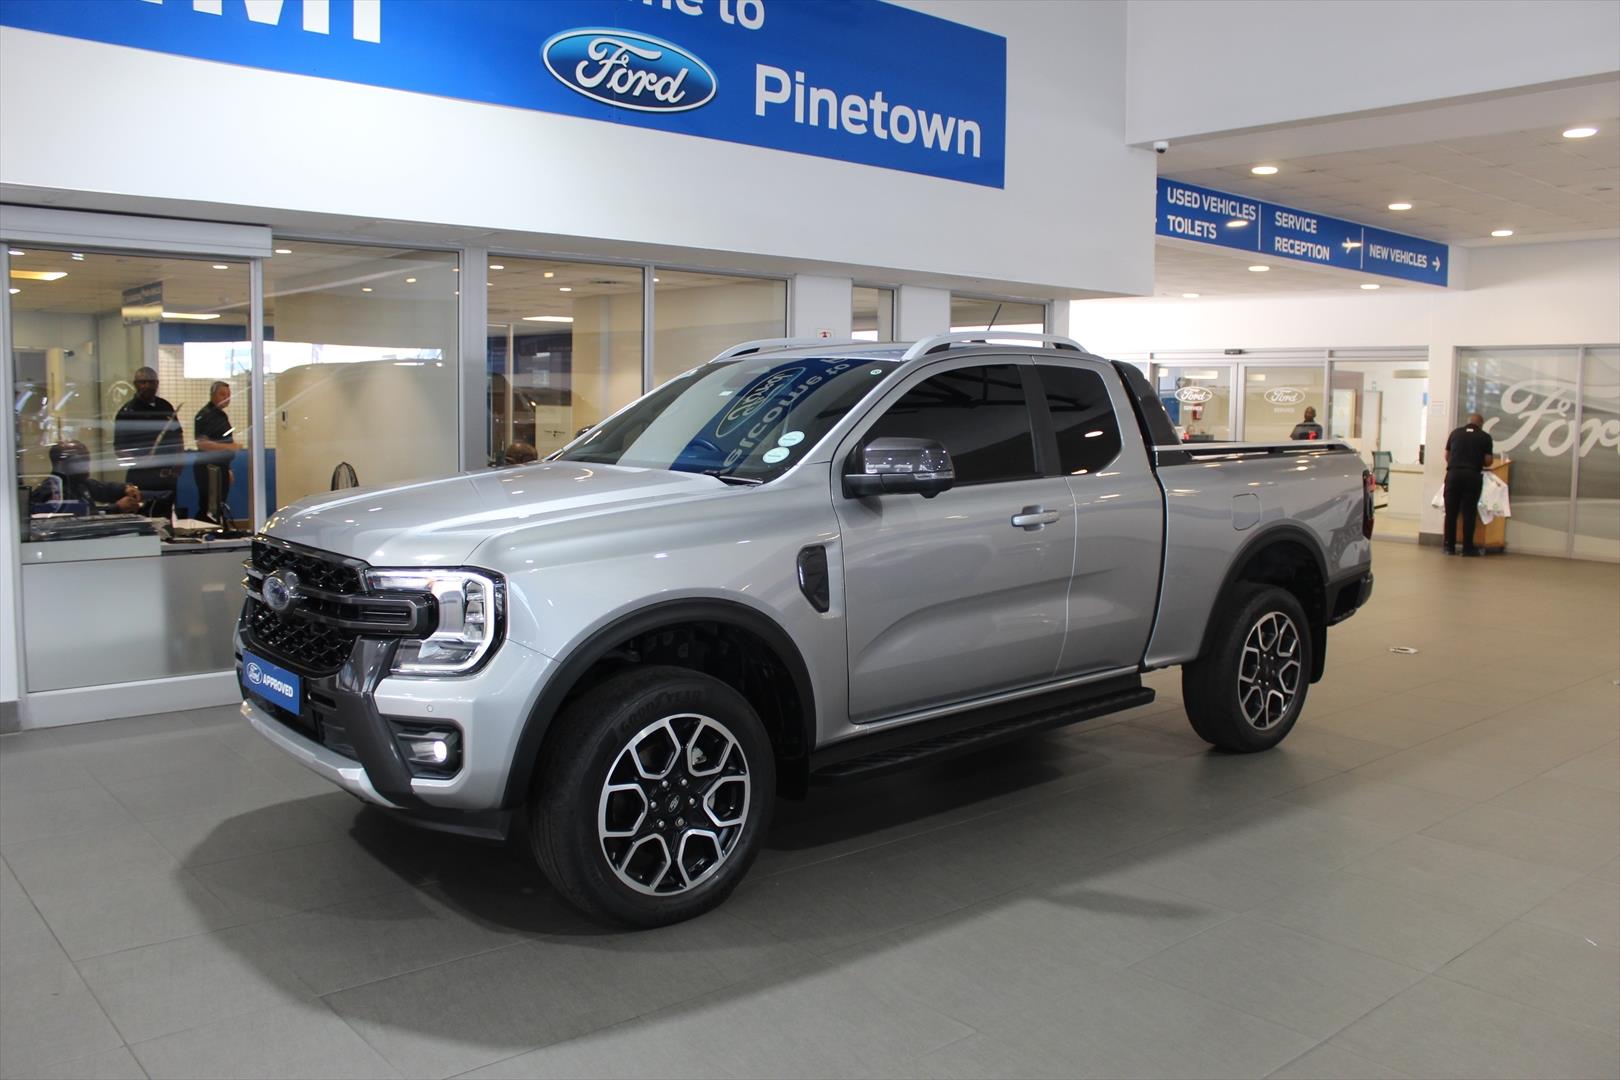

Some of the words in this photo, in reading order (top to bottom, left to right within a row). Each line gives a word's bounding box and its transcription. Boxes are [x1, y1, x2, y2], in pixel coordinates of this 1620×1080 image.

[575, 37, 688, 103] Ford
[755, 63, 981, 158] Pinetown
[1167, 186, 1201, 209] USED
[1202, 195, 1257, 221] VEHICLES
[1167, 215, 1217, 239] TOILETS
[1274, 211, 1318, 234] SERVICE
[1274, 236, 1330, 261] RECEPTION
[1369, 244, 1389, 260] NEW
[1390, 247, 1428, 269] VEHICLES
[1180, 387, 1206, 401] Ford
[1271, 389, 1298, 402] Ford
[1482, 379, 1620, 458] For
[262, 673, 294, 698] APPROVED
